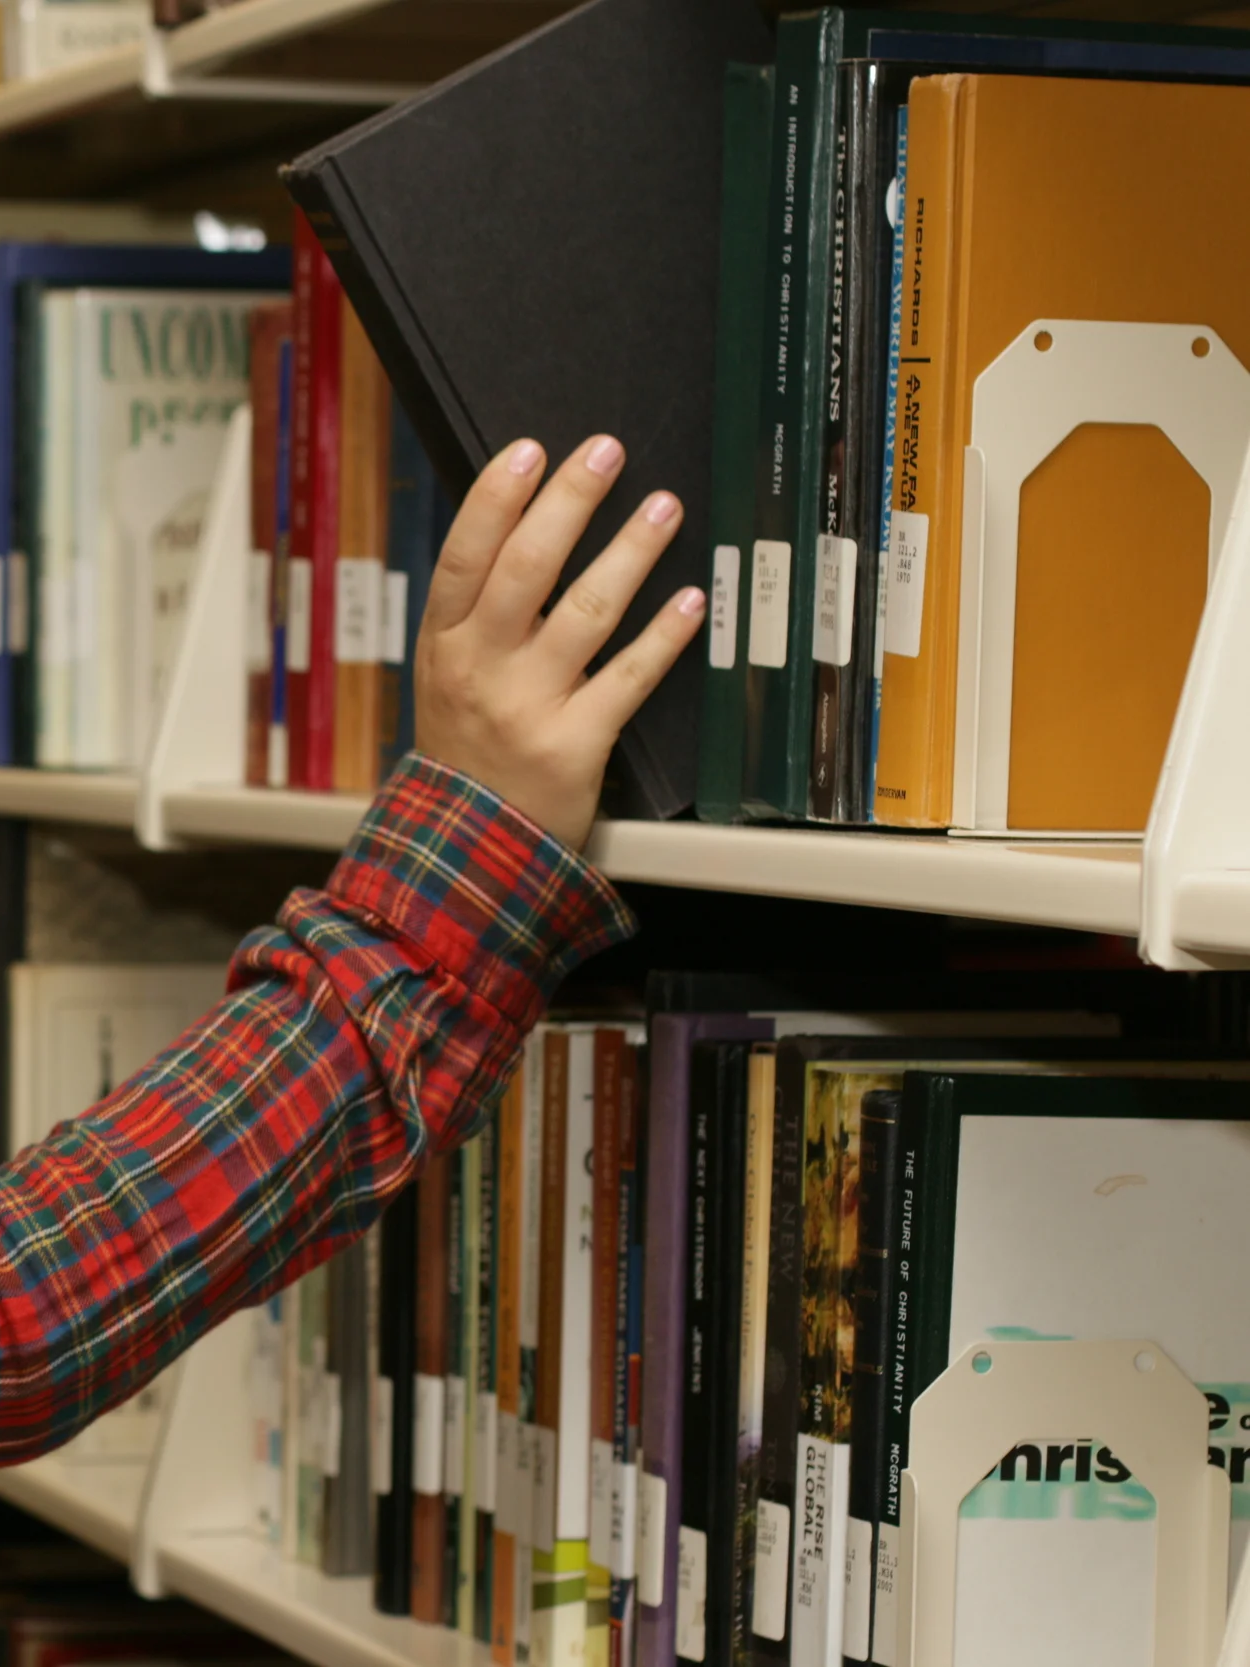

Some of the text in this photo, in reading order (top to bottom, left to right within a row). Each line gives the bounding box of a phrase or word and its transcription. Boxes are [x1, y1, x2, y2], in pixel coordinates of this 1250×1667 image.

[771, 84, 799, 496] AN INTRODUCTION TO CHRISTIANITY MCGRATH
[910, 197, 925, 347] RICHARDS
[827, 126, 847, 535] The CHRISTIANS McK
[887, 280, 902, 388] WORLD
[884, 399, 898, 456] MAY
[903, 375, 915, 431] THE
[906, 374, 921, 514] A NEW FA
[896, 571, 911, 584] 1970
[898, 545, 917, 557] 121.2
[820, 692, 829, 754] Abingdon
[877, 786, 907, 800] ZONDERVAN
[601, 1103, 615, 1189] Gospel
[619, 1183, 630, 1254] FROM
[780, 1115, 798, 1283] THE NEW
[615, 1260, 628, 1333] TIMES
[691, 1113, 707, 1394] THE NEXT CHRISTENDOM JENKINS
[886, 1149, 915, 1517] THE FUTURE OF CHRISTIANITY MCGRATH
[613, 1339, 626, 1435] SQUARE
[813, 1383, 823, 1422] KIM
[803, 1445, 816, 1543] GLOBAL
[814, 1451, 827, 1562] THE RISE
[877, 1580, 893, 1594] 2002
[878, 1553, 899, 1568] 121.3
